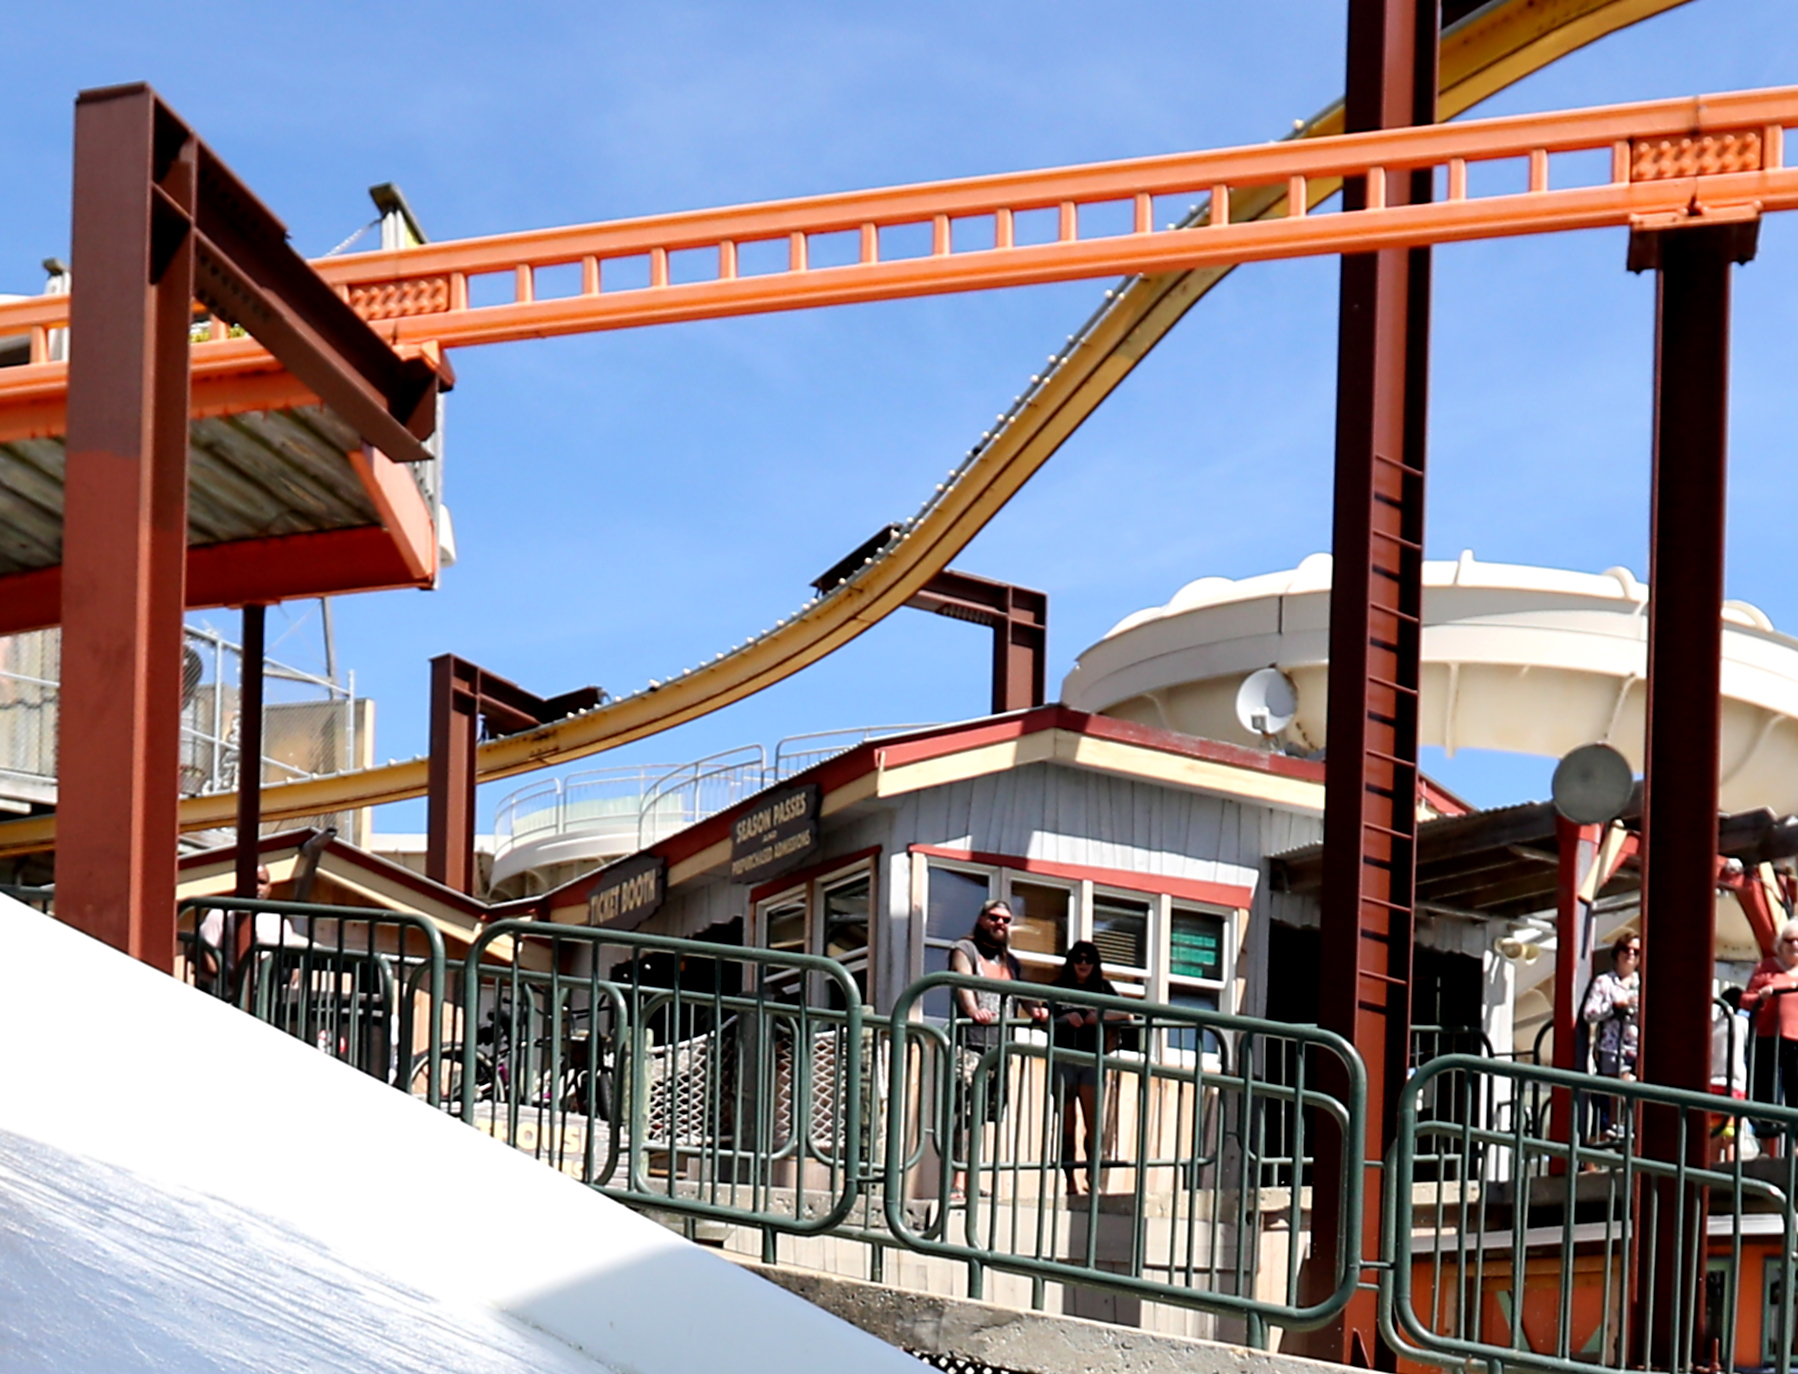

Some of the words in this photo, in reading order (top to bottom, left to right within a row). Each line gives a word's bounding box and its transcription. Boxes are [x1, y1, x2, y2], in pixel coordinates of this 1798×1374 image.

[736, 807, 772, 843] SEASON
[773, 791, 807, 826] PASSES
[591, 885, 620, 926] TICKET
[621, 868, 656, 913] BOOTH
